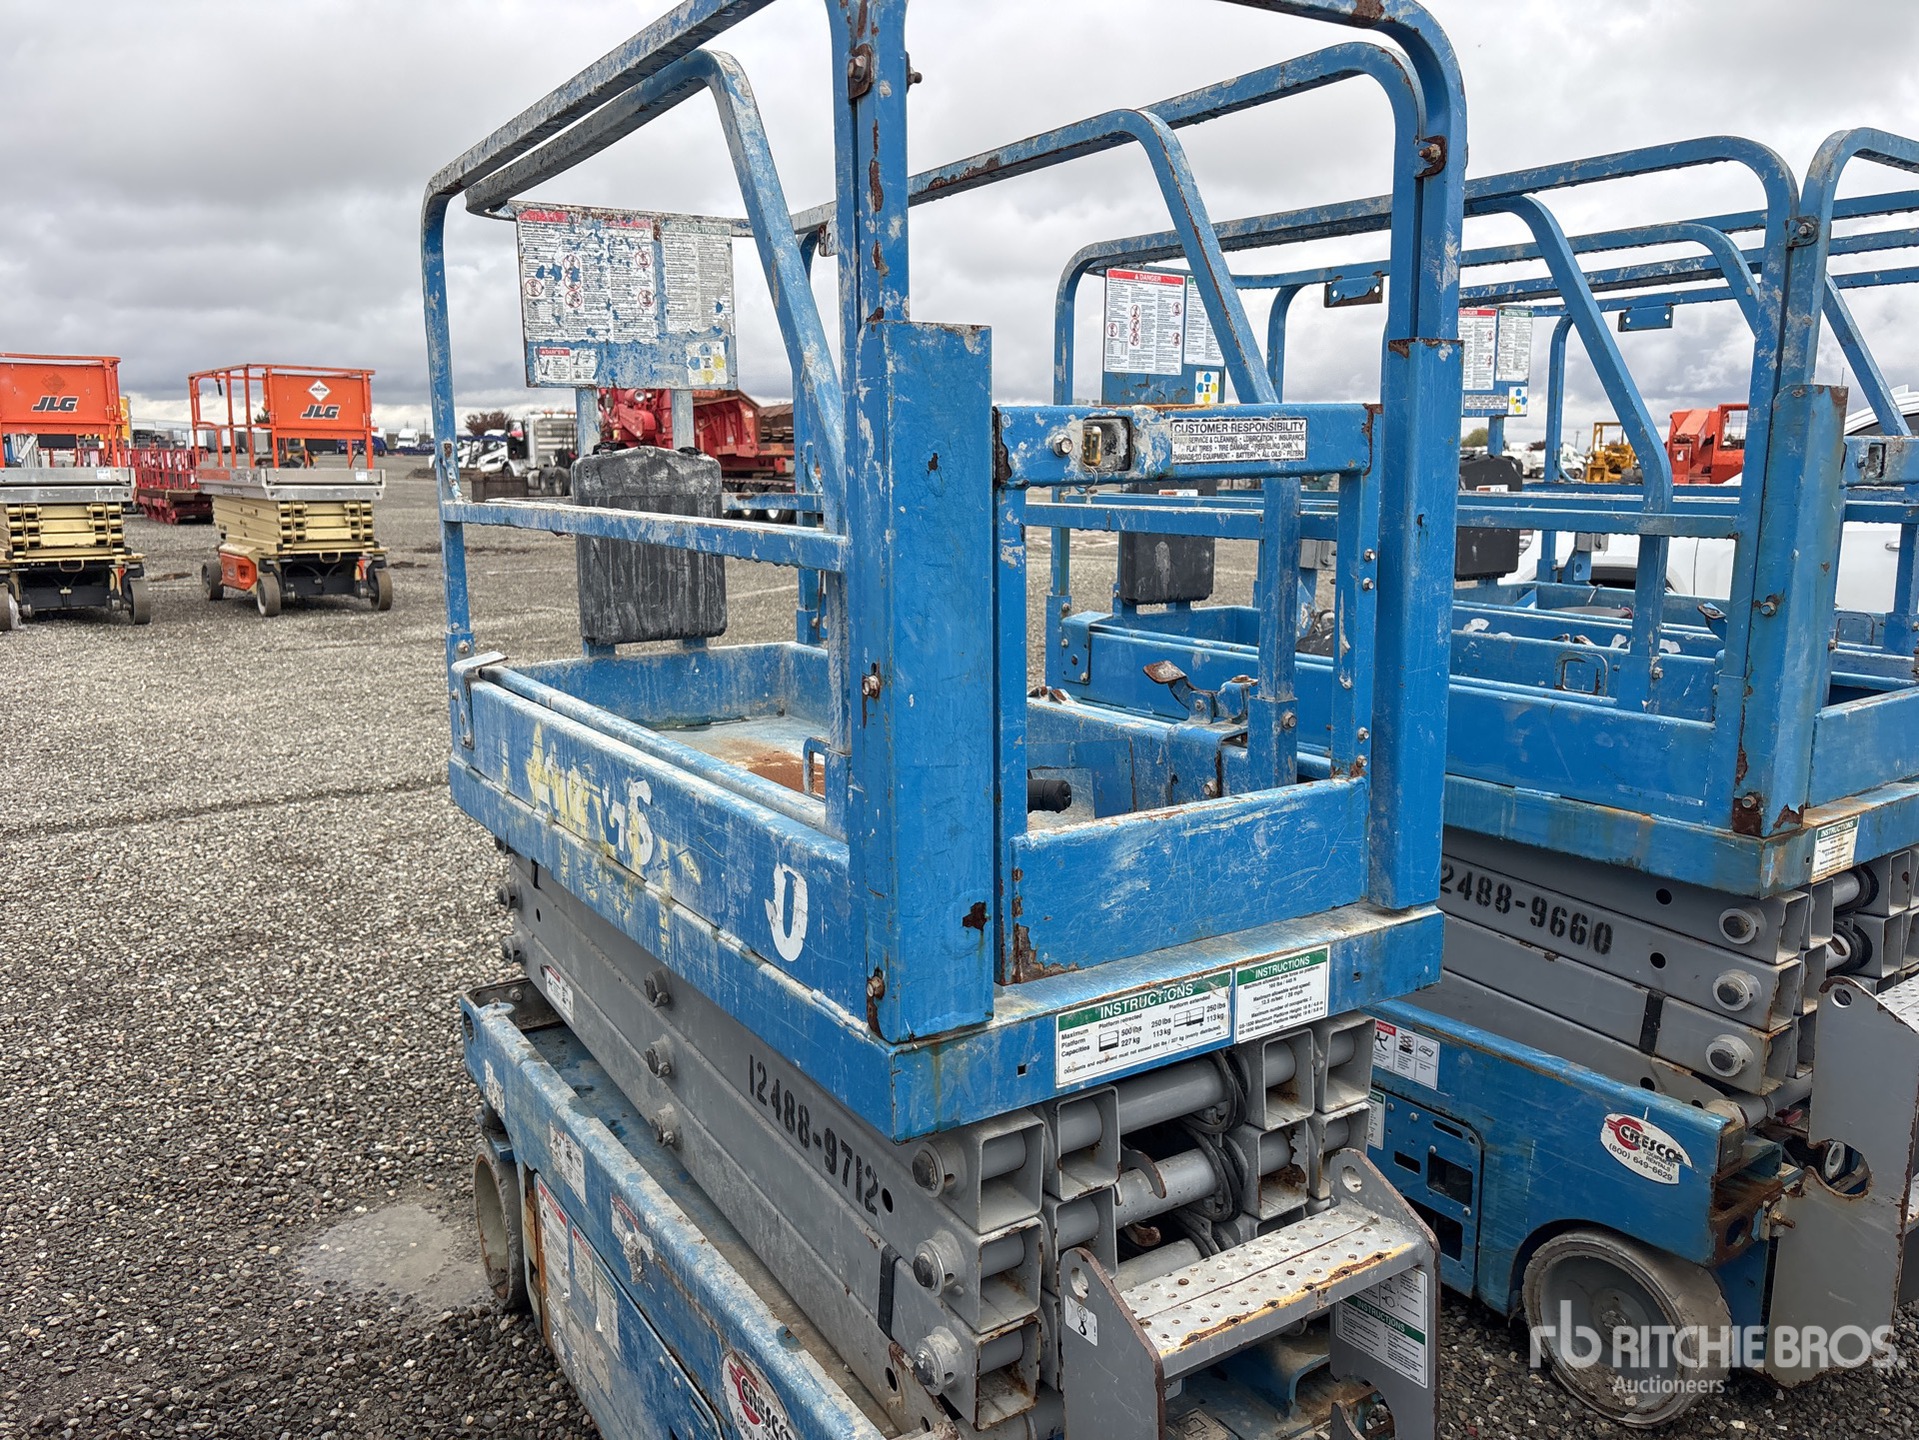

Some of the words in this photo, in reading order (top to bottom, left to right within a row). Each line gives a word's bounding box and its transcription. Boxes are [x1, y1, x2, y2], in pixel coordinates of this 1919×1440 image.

[1140, 274, 1161, 282] DANGER
[31, 396, 79, 412] JLG
[301, 404, 340, 420] JLG
[1174, 423, 1228, 434] CUSTOMER
[1231, 421, 1304, 432] RESPONSIBILITY
[1203, 452, 1230, 460] EQUIPMENT
[1820, 821, 1854, 837] INSTRUCTIONS
[1255, 955, 1310, 979] INSTRUCTIONS
[1100, 983, 1194, 1019] INSTRUCTIONS
[1169, 1000, 1188, 1010] Platform
[1189, 994, 1211, 1005] extended
[1253, 992, 1271, 1002] Maximum
[1207, 1004, 1217, 1012] 250
[1251, 1009, 1269, 1018] Maximum
[1269, 1004, 1284, 1012] number
[1099, 1019, 1119, 1029] Platform
[1120, 1013, 1142, 1023] retracted
[1151, 1019, 1162, 1028] 250
[1162, 1017, 1171, 1025] lbs
[1207, 1014, 1217, 1022] 113
[1061, 1028, 1089, 1040] Maximum
[1121, 1027, 1132, 1036] 500
[1133, 1025, 1142, 1034] lbs
[1153, 1029, 1163, 1037] 113
[1164, 1028, 1171, 1036] kg
[1061, 1038, 1086, 1049] Platform
[1121, 1038, 1132, 1047] 227
[1132, 1037, 1141, 1045] kg
[1061, 1045, 1090, 1058] Capacities
[749, 1054, 879, 1216] 12488-9712
[1620, 1125, 1678, 1162] CRESCO
[1609, 1143, 1631, 1160] (800)
[1633, 1156, 1673, 1181] 649-6629
[1643, 1149, 1676, 1169] EQUIPMENT
[1645, 1155, 1671, 1172] RENTALS
[1356, 1300, 1406, 1333] INSTRUCTIONS
